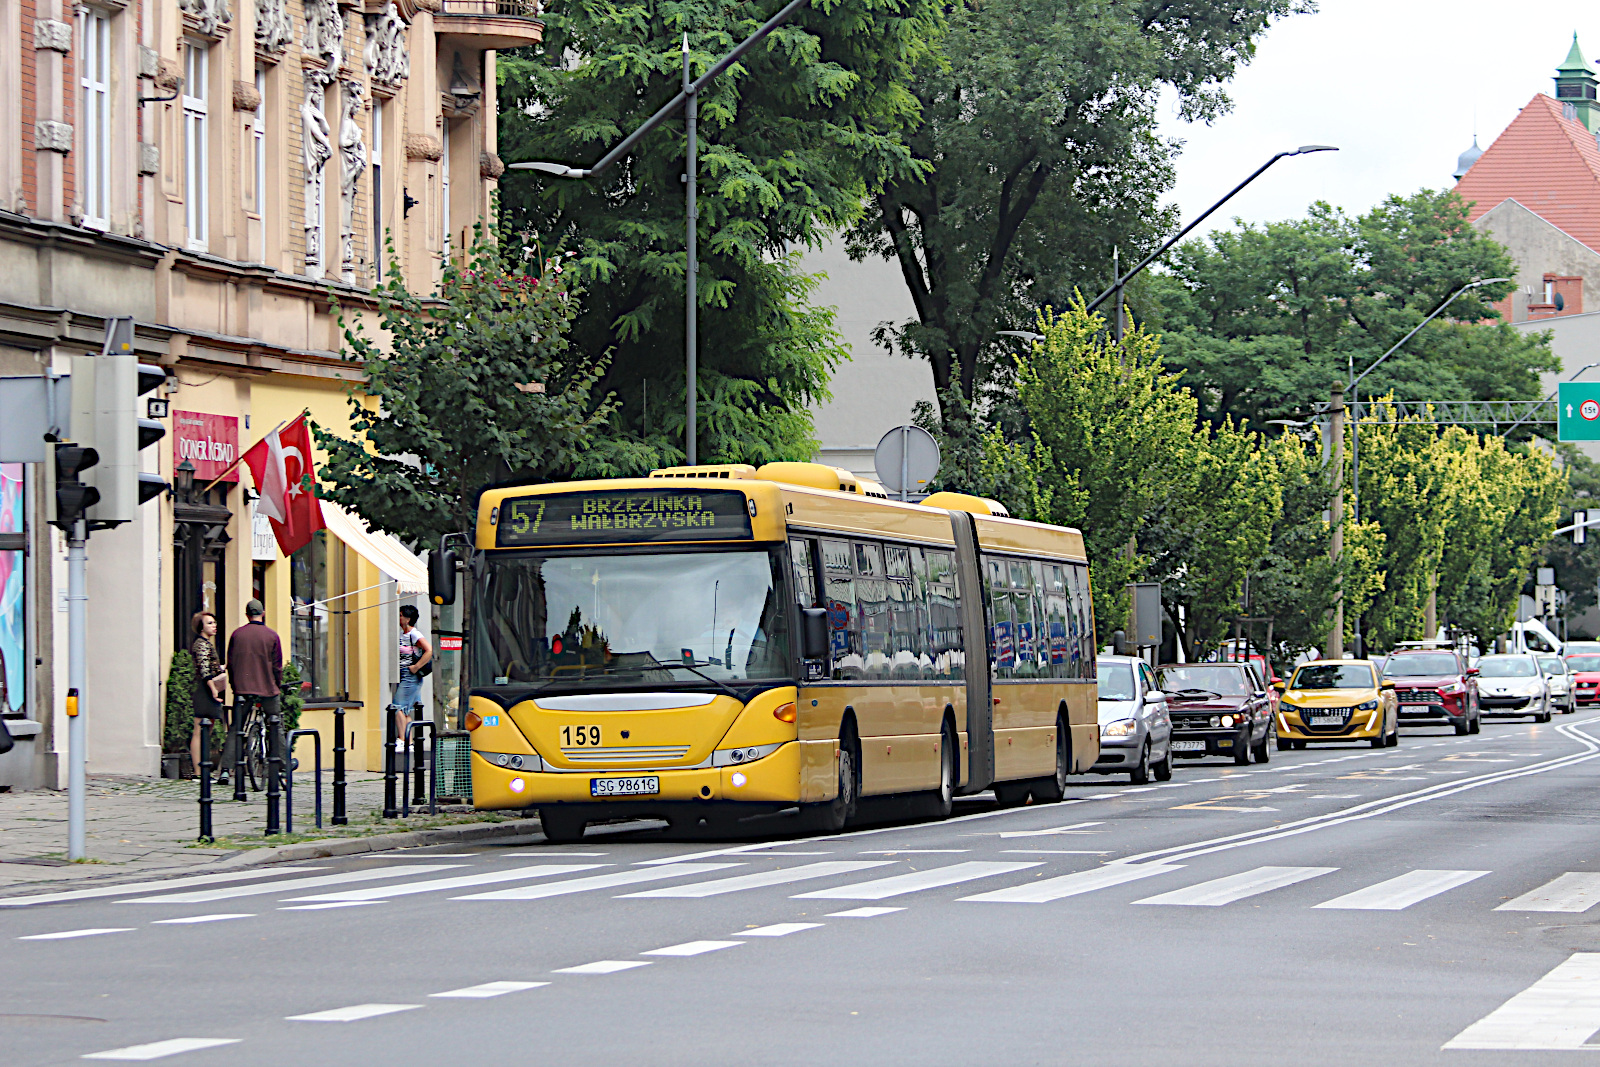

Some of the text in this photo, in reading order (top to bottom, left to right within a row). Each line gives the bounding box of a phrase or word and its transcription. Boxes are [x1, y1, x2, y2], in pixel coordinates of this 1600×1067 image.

[1584, 406, 1597, 414] 15t
[583, 495, 702, 514] BRZEZINKA
[511, 500, 546, 534] 57
[571, 510, 715, 530] WAŁBRZYSKA
[562, 726, 601, 746] 159
[1171, 741, 1205, 749] SG 7377S
[599, 780, 614, 792] SG
[618, 778, 655, 791] 9861G
